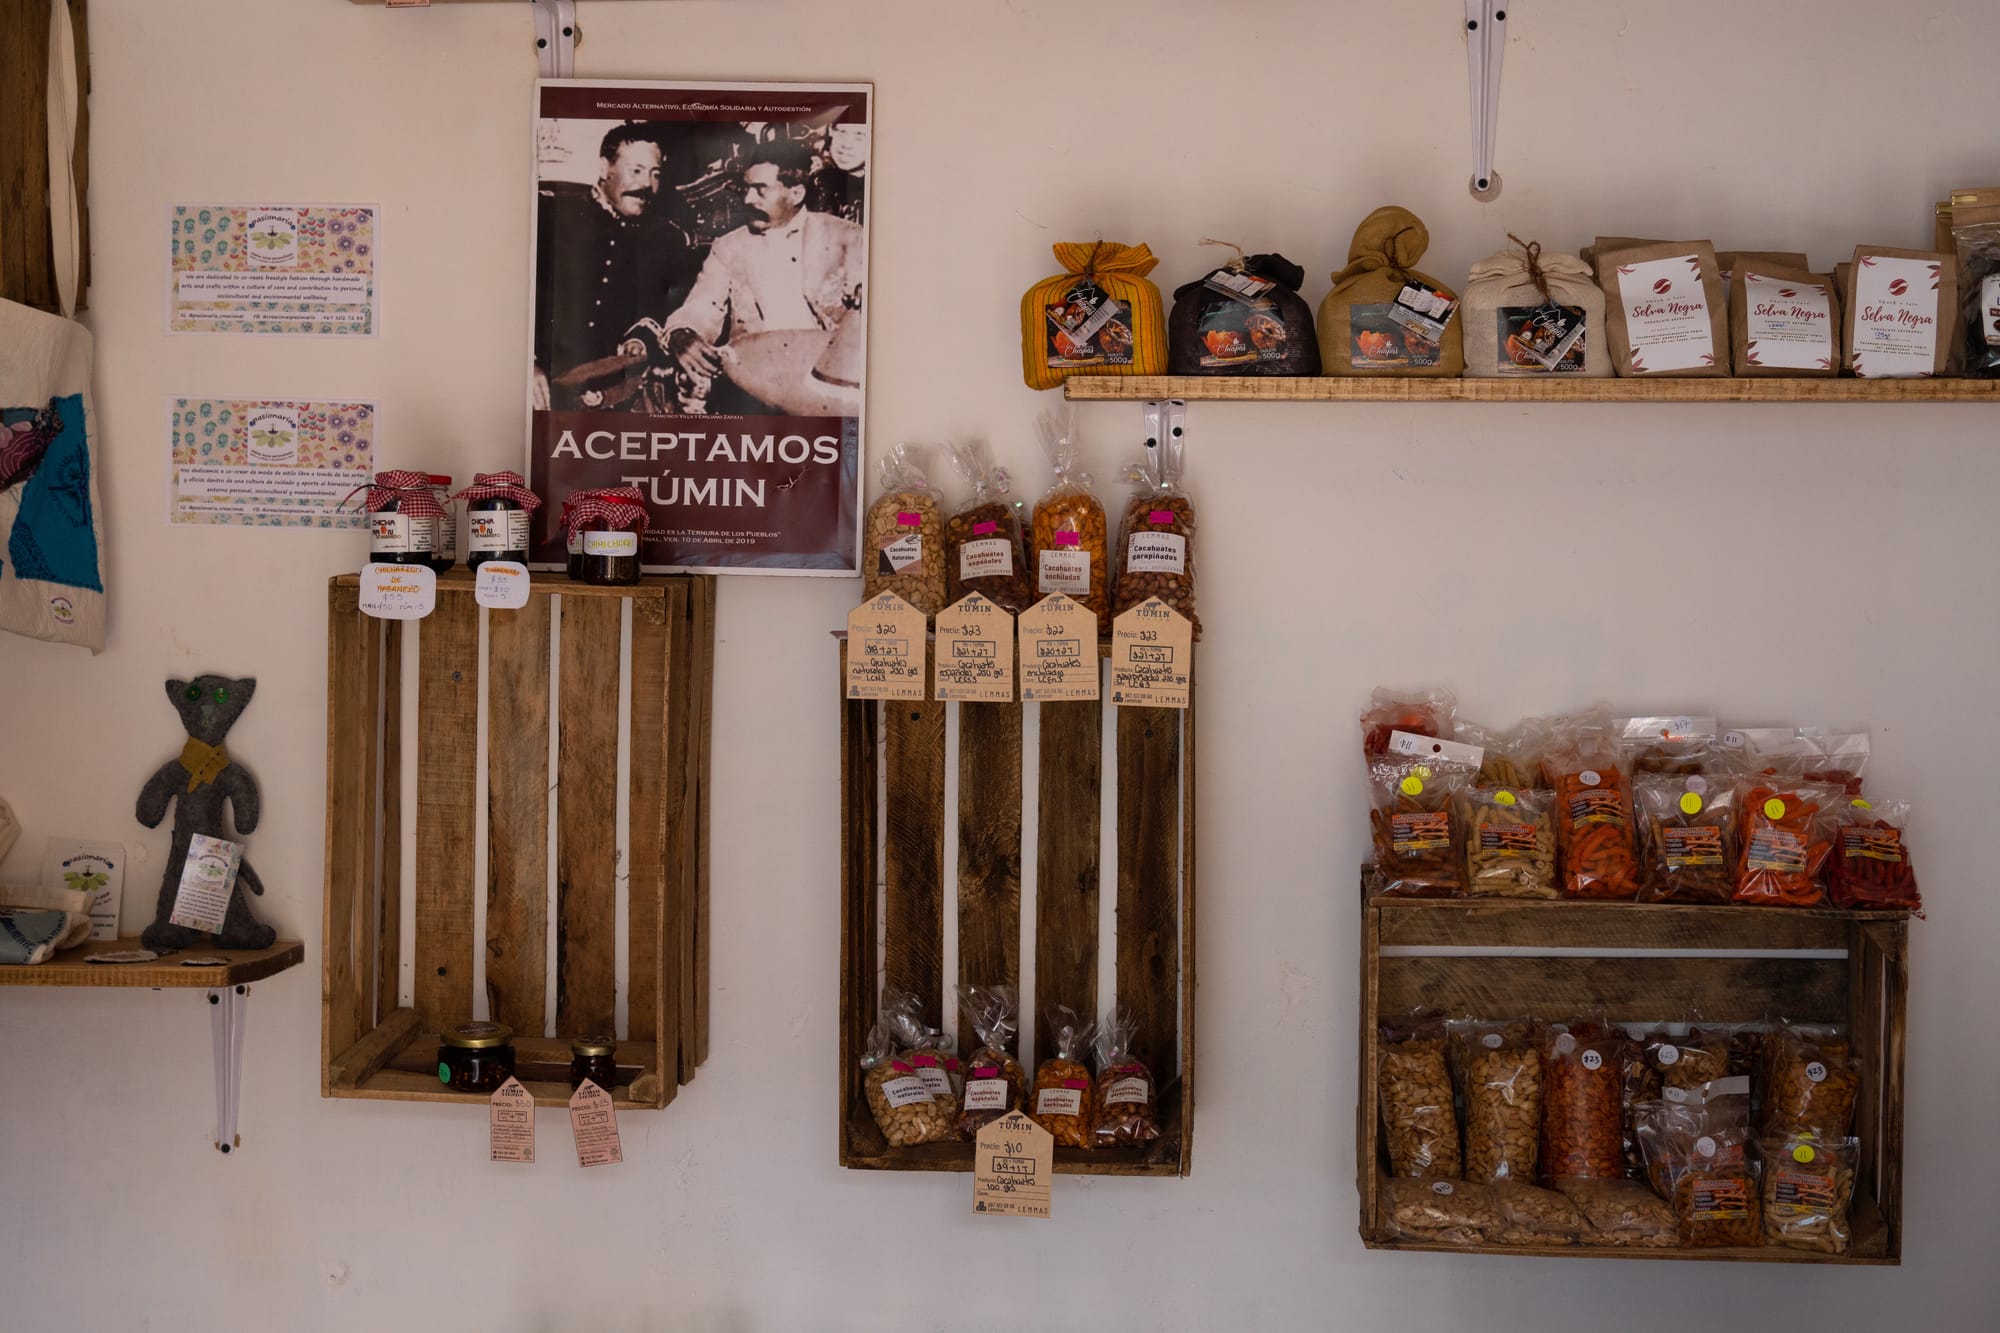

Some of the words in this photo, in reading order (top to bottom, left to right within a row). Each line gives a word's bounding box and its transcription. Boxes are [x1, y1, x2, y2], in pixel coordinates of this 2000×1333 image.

[251, 213, 293, 226] pasionaria
[1632, 304, 1665, 318] Selva
[1668, 302, 1704, 316] Negra
[1754, 304, 1787, 316] Selva
[1791, 306, 1825, 322] Negra
[1861, 306, 1895, 322] Selva
[1897, 309, 1933, 329] Negra
[252, 412, 293, 425] pasionaria
[550, 430, 839, 465] ACEPTAMOS
[621, 469, 766, 507] TÚMIN
[1134, 545, 1176, 553] Cacahuates
[966, 552, 1004, 560] Cacahuates
[1132, 553, 1177, 561] garapiñados
[1044, 564, 1082, 572] Cacahuates
[1045, 573, 1080, 581] enchilados
[876, 624, 897, 634] $20
[961, 624, 981, 636] $23
[1140, 630, 1157, 641] $23
[891, 688, 922, 697] LEMMAS
[980, 690, 1010, 698] LEMMAS
[1065, 688, 1096, 697] LEMMAS
[1155, 696, 1186, 704] LEMMAS
[1807, 1066, 1823, 1077] $23
[892, 1086, 925, 1095] Cacahuates
[898, 1091, 925, 1099] naturales
[980, 1142, 1000, 1150] Precio:
[1004, 1141, 1023, 1157] $10
[1017, 1206, 1048, 1214] LEMMAS
